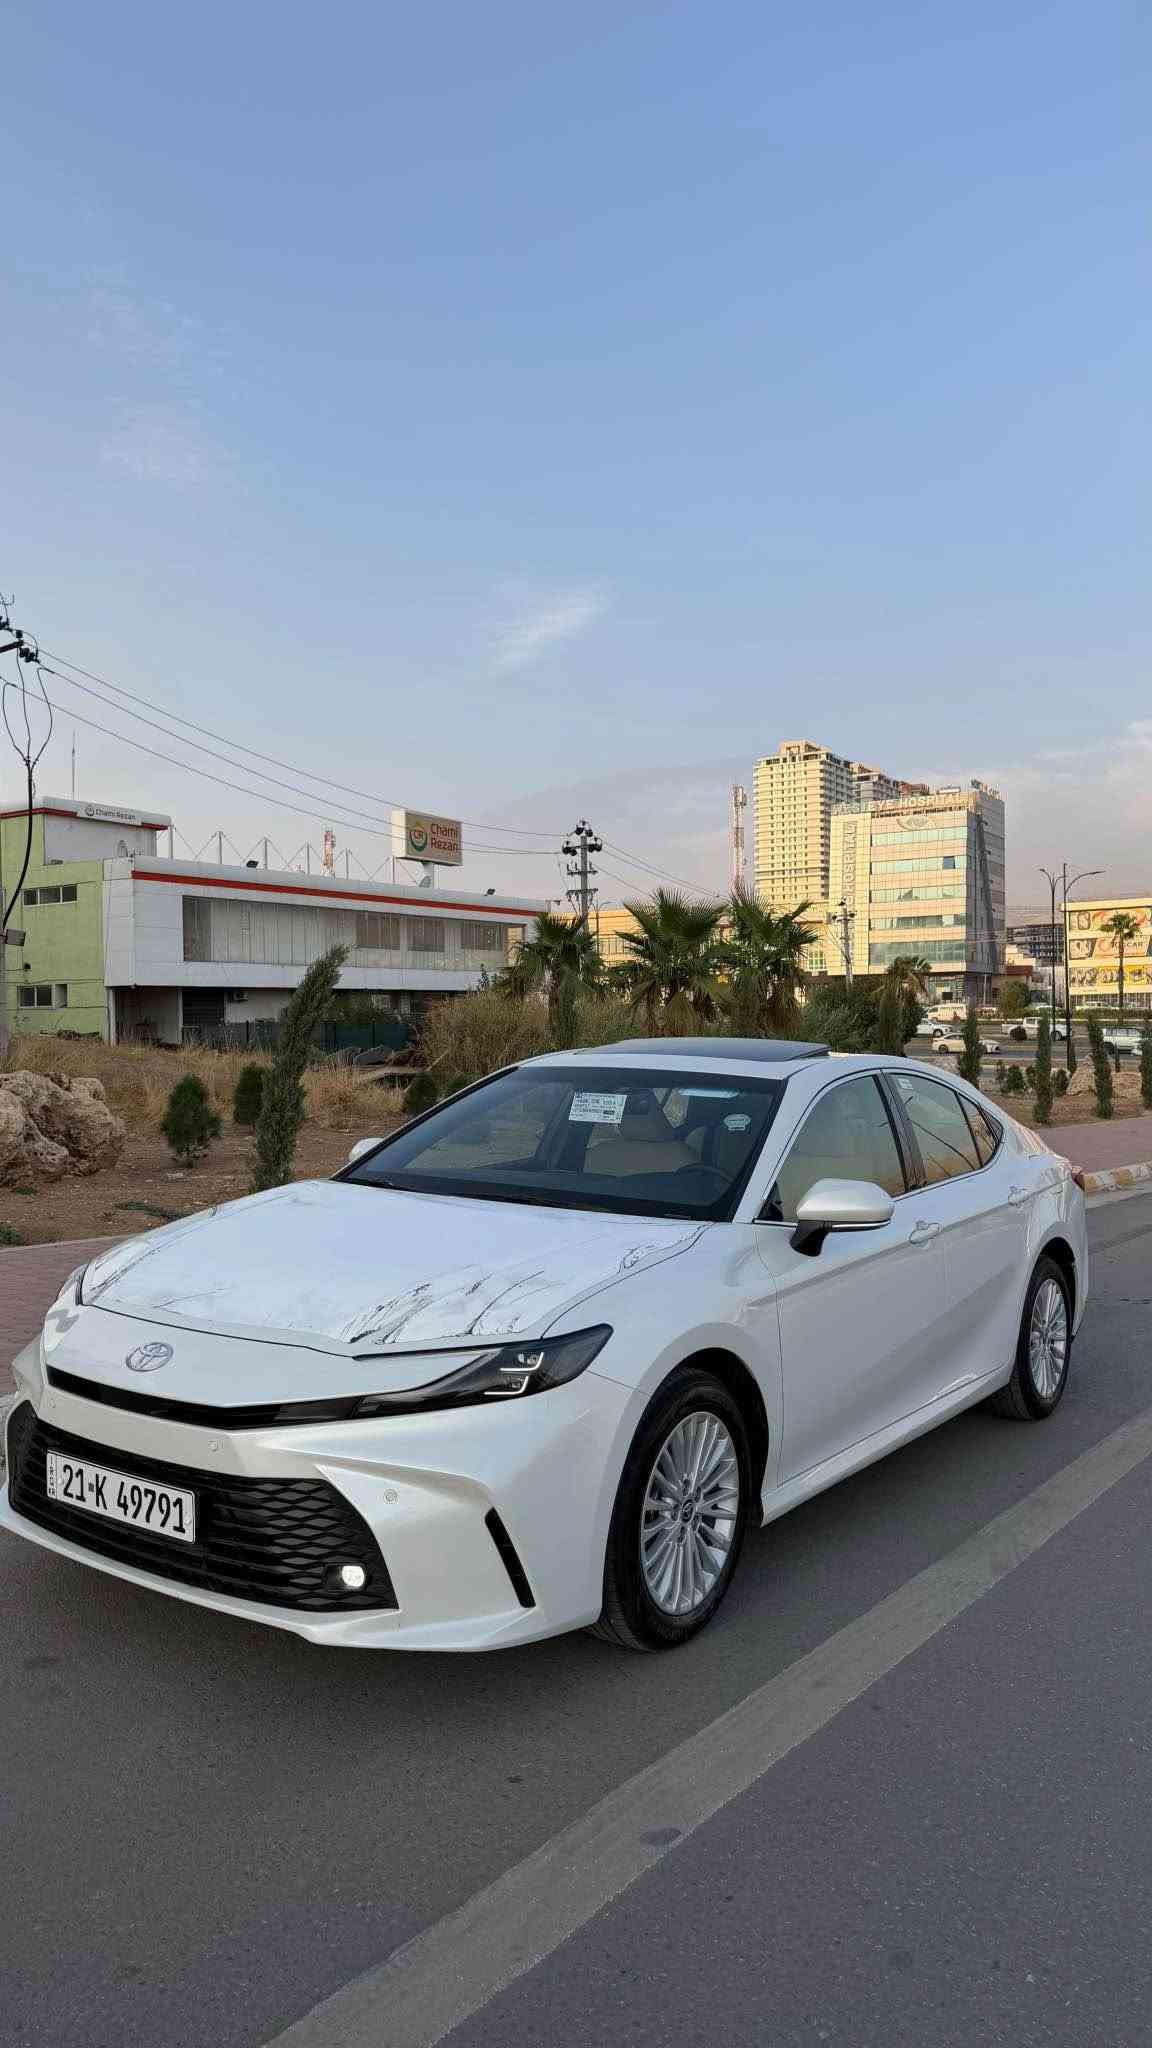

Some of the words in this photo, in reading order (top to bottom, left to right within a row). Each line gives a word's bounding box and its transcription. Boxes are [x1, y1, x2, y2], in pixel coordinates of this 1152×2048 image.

[899, 793, 965, 808] HOSPITAL
[430, 823, 458, 837] Chami
[430, 837, 458, 851] Rezan
[117, 1481, 186, 1533] 49791
